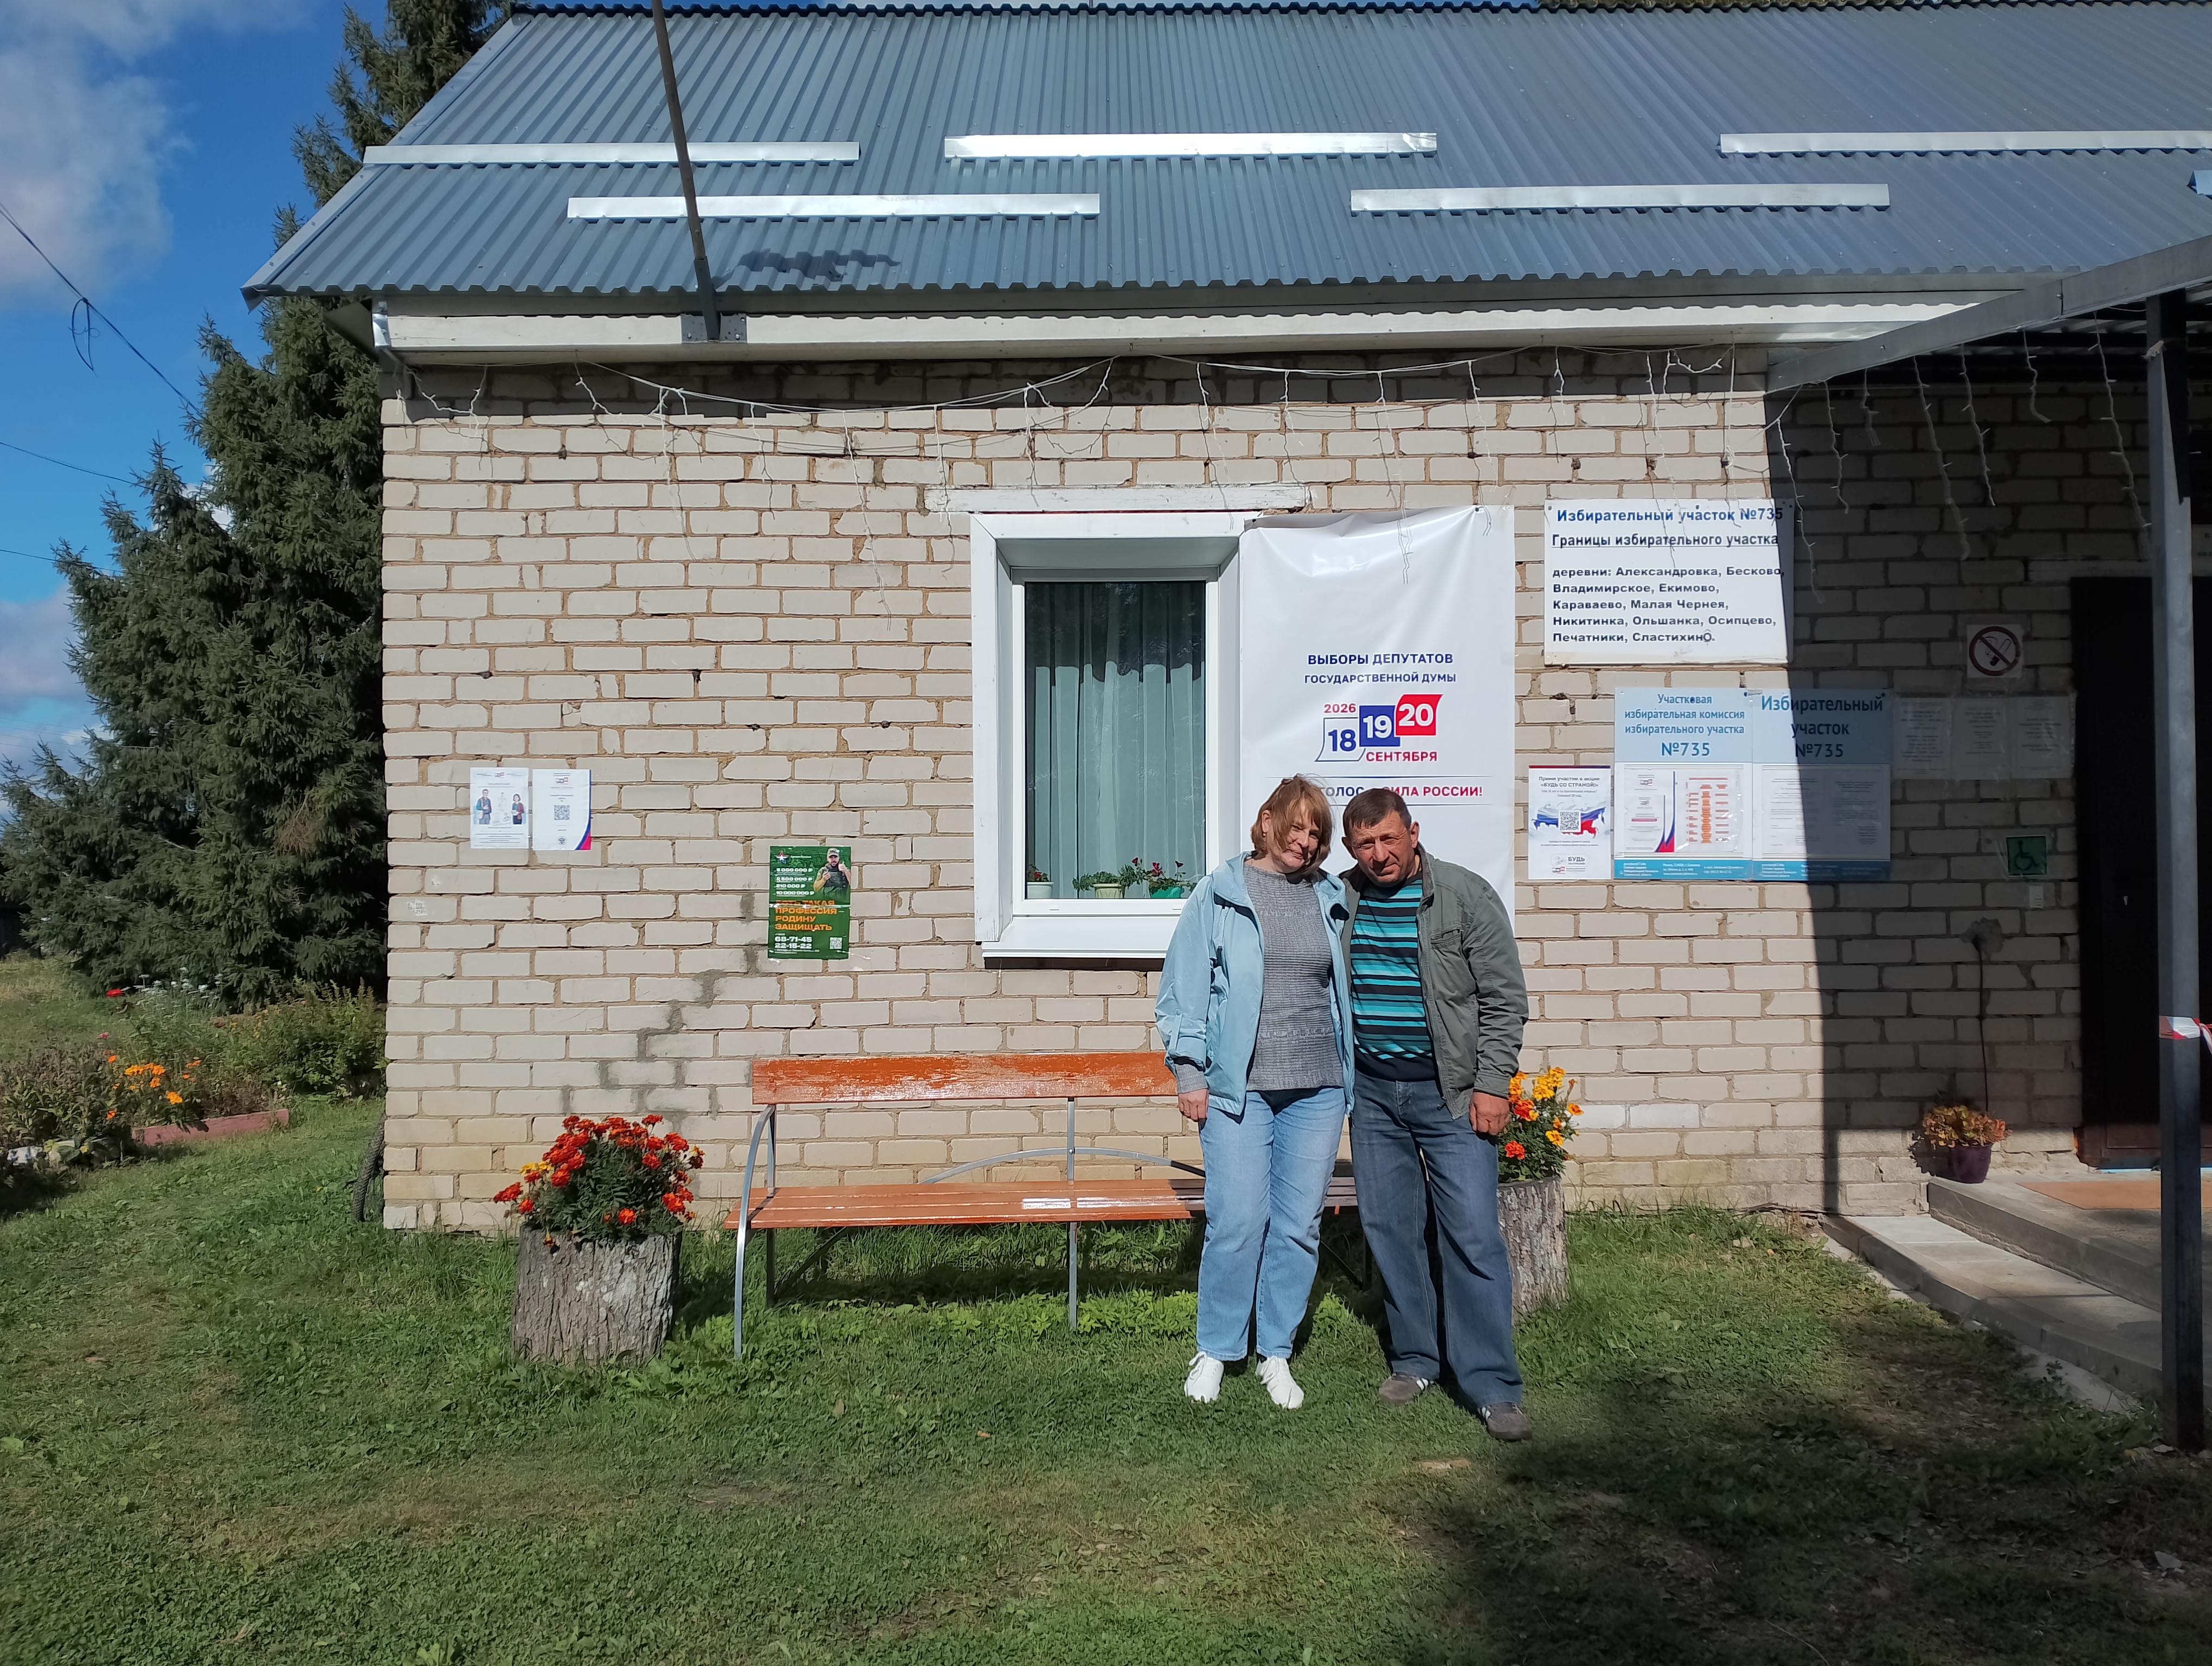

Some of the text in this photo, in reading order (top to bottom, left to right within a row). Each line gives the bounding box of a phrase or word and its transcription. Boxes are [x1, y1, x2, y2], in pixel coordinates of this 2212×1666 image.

[1557, 508, 1783, 524] Избирательный участок №735
[1552, 533, 1778, 548] Границы избирательного участка
[1552, 566, 1785, 579] деревни: Александровка, Бесково,
[1553, 584, 1719, 594] Владимирское, Екимово,
[1553, 599, 1729, 611] Караваево, Малая Чернея,
[1553, 616, 1776, 627] Никитинка, Ольшанка, Осипцево,
[1553, 633, 1628, 644] Печатники,
[1308, 653, 1454, 665] ВЫБОРЫ ДЕПУТАТОВ
[1304, 671, 1456, 684] ГОСУДАРСТВЕННОЙ ДУМЫ
[1657, 694, 1712, 704] Участковая
[1761, 694, 1883, 714] Избирательный
[1323, 703, 1356, 713] 2026
[1624, 709, 1745, 721] избирательная комиссия
[1328, 703, 1434, 752] 18 19 20
[1625, 723, 1745, 736] избирательного участка
[1790, 723, 1850, 739] участок
[1661, 742, 1711, 757] №735
[1795, 743, 1843, 758] №735
[1366, 752, 1437, 761] СЕНТЯБРЯ
[1423, 786, 1483, 797] РОССИИ!
